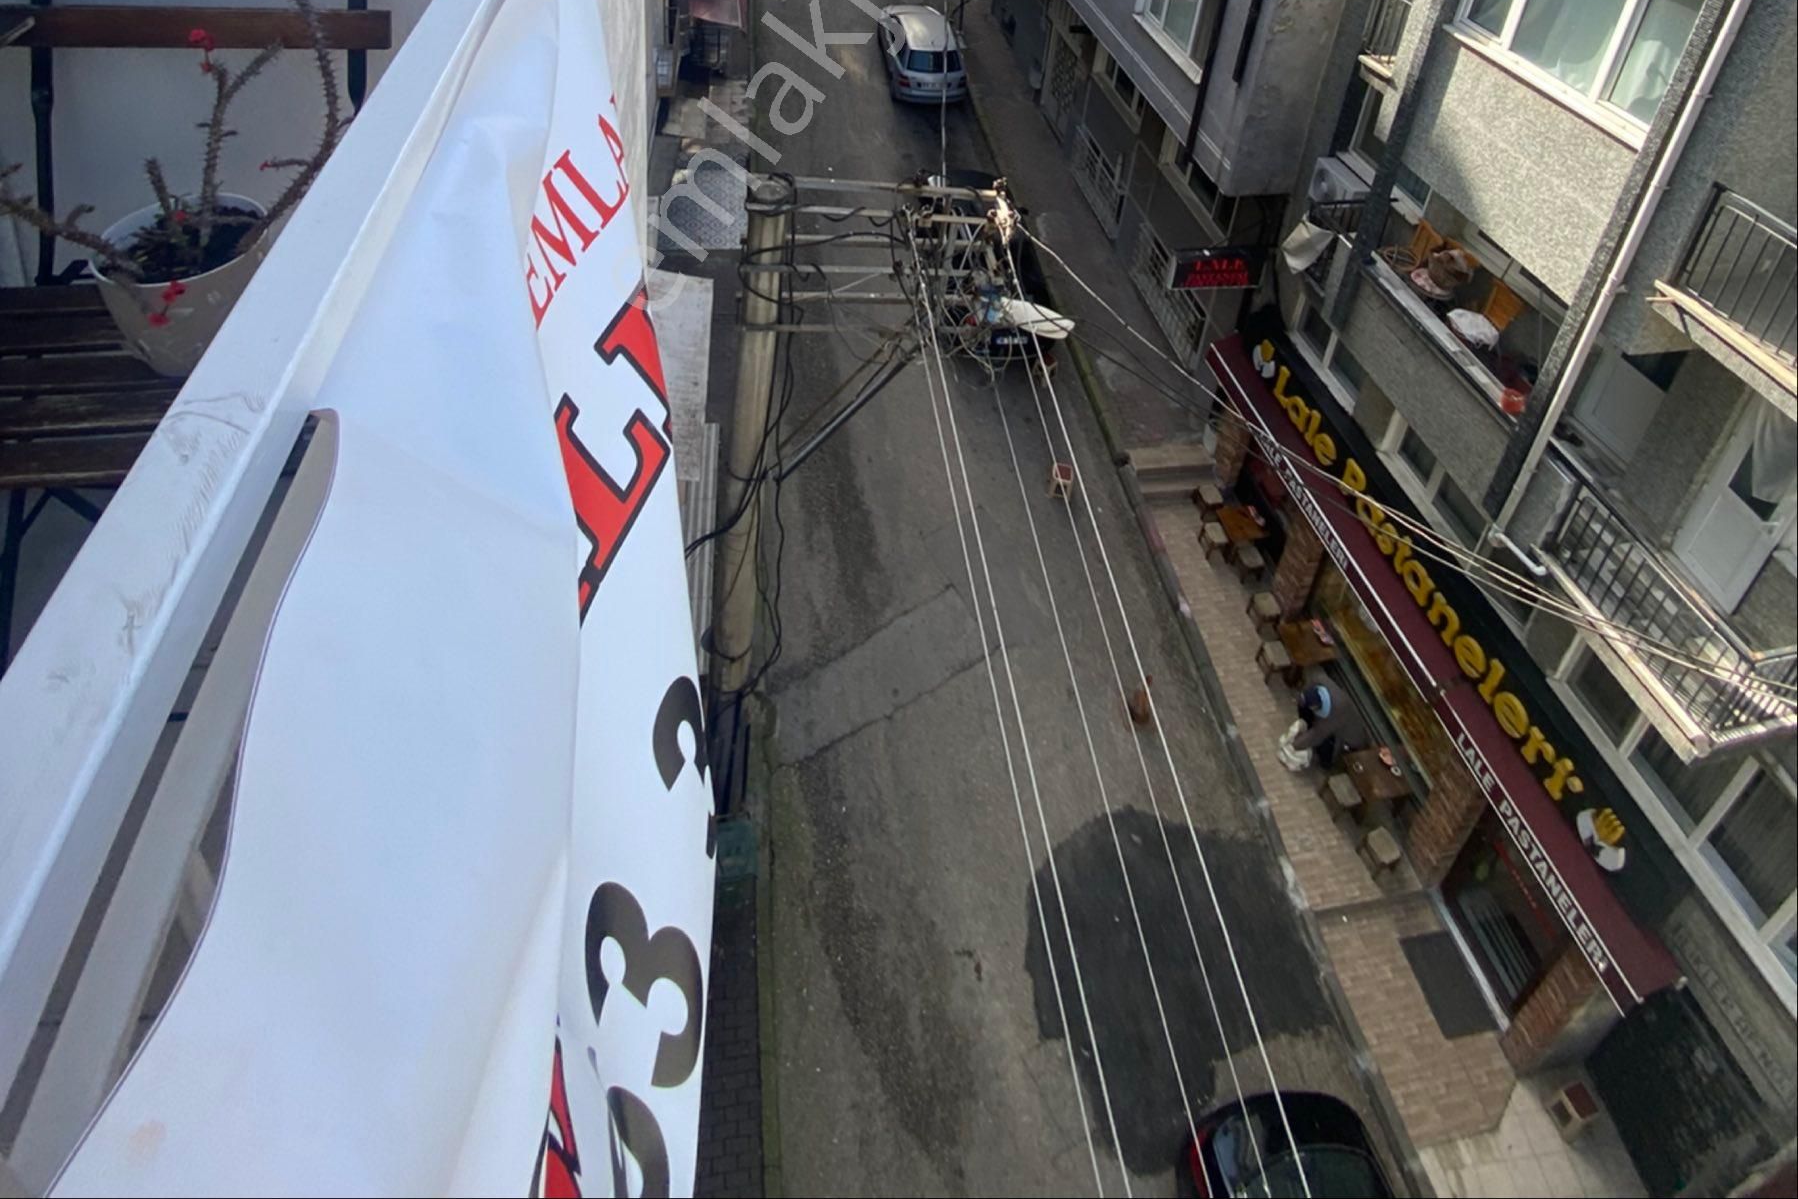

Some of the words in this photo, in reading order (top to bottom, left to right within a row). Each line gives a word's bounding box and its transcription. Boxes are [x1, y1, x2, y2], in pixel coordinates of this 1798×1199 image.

[1273, 365, 1337, 466] Lale
[1339, 457, 1584, 801] Pastaneleri
[1456, 732, 1496, 793] LALE
